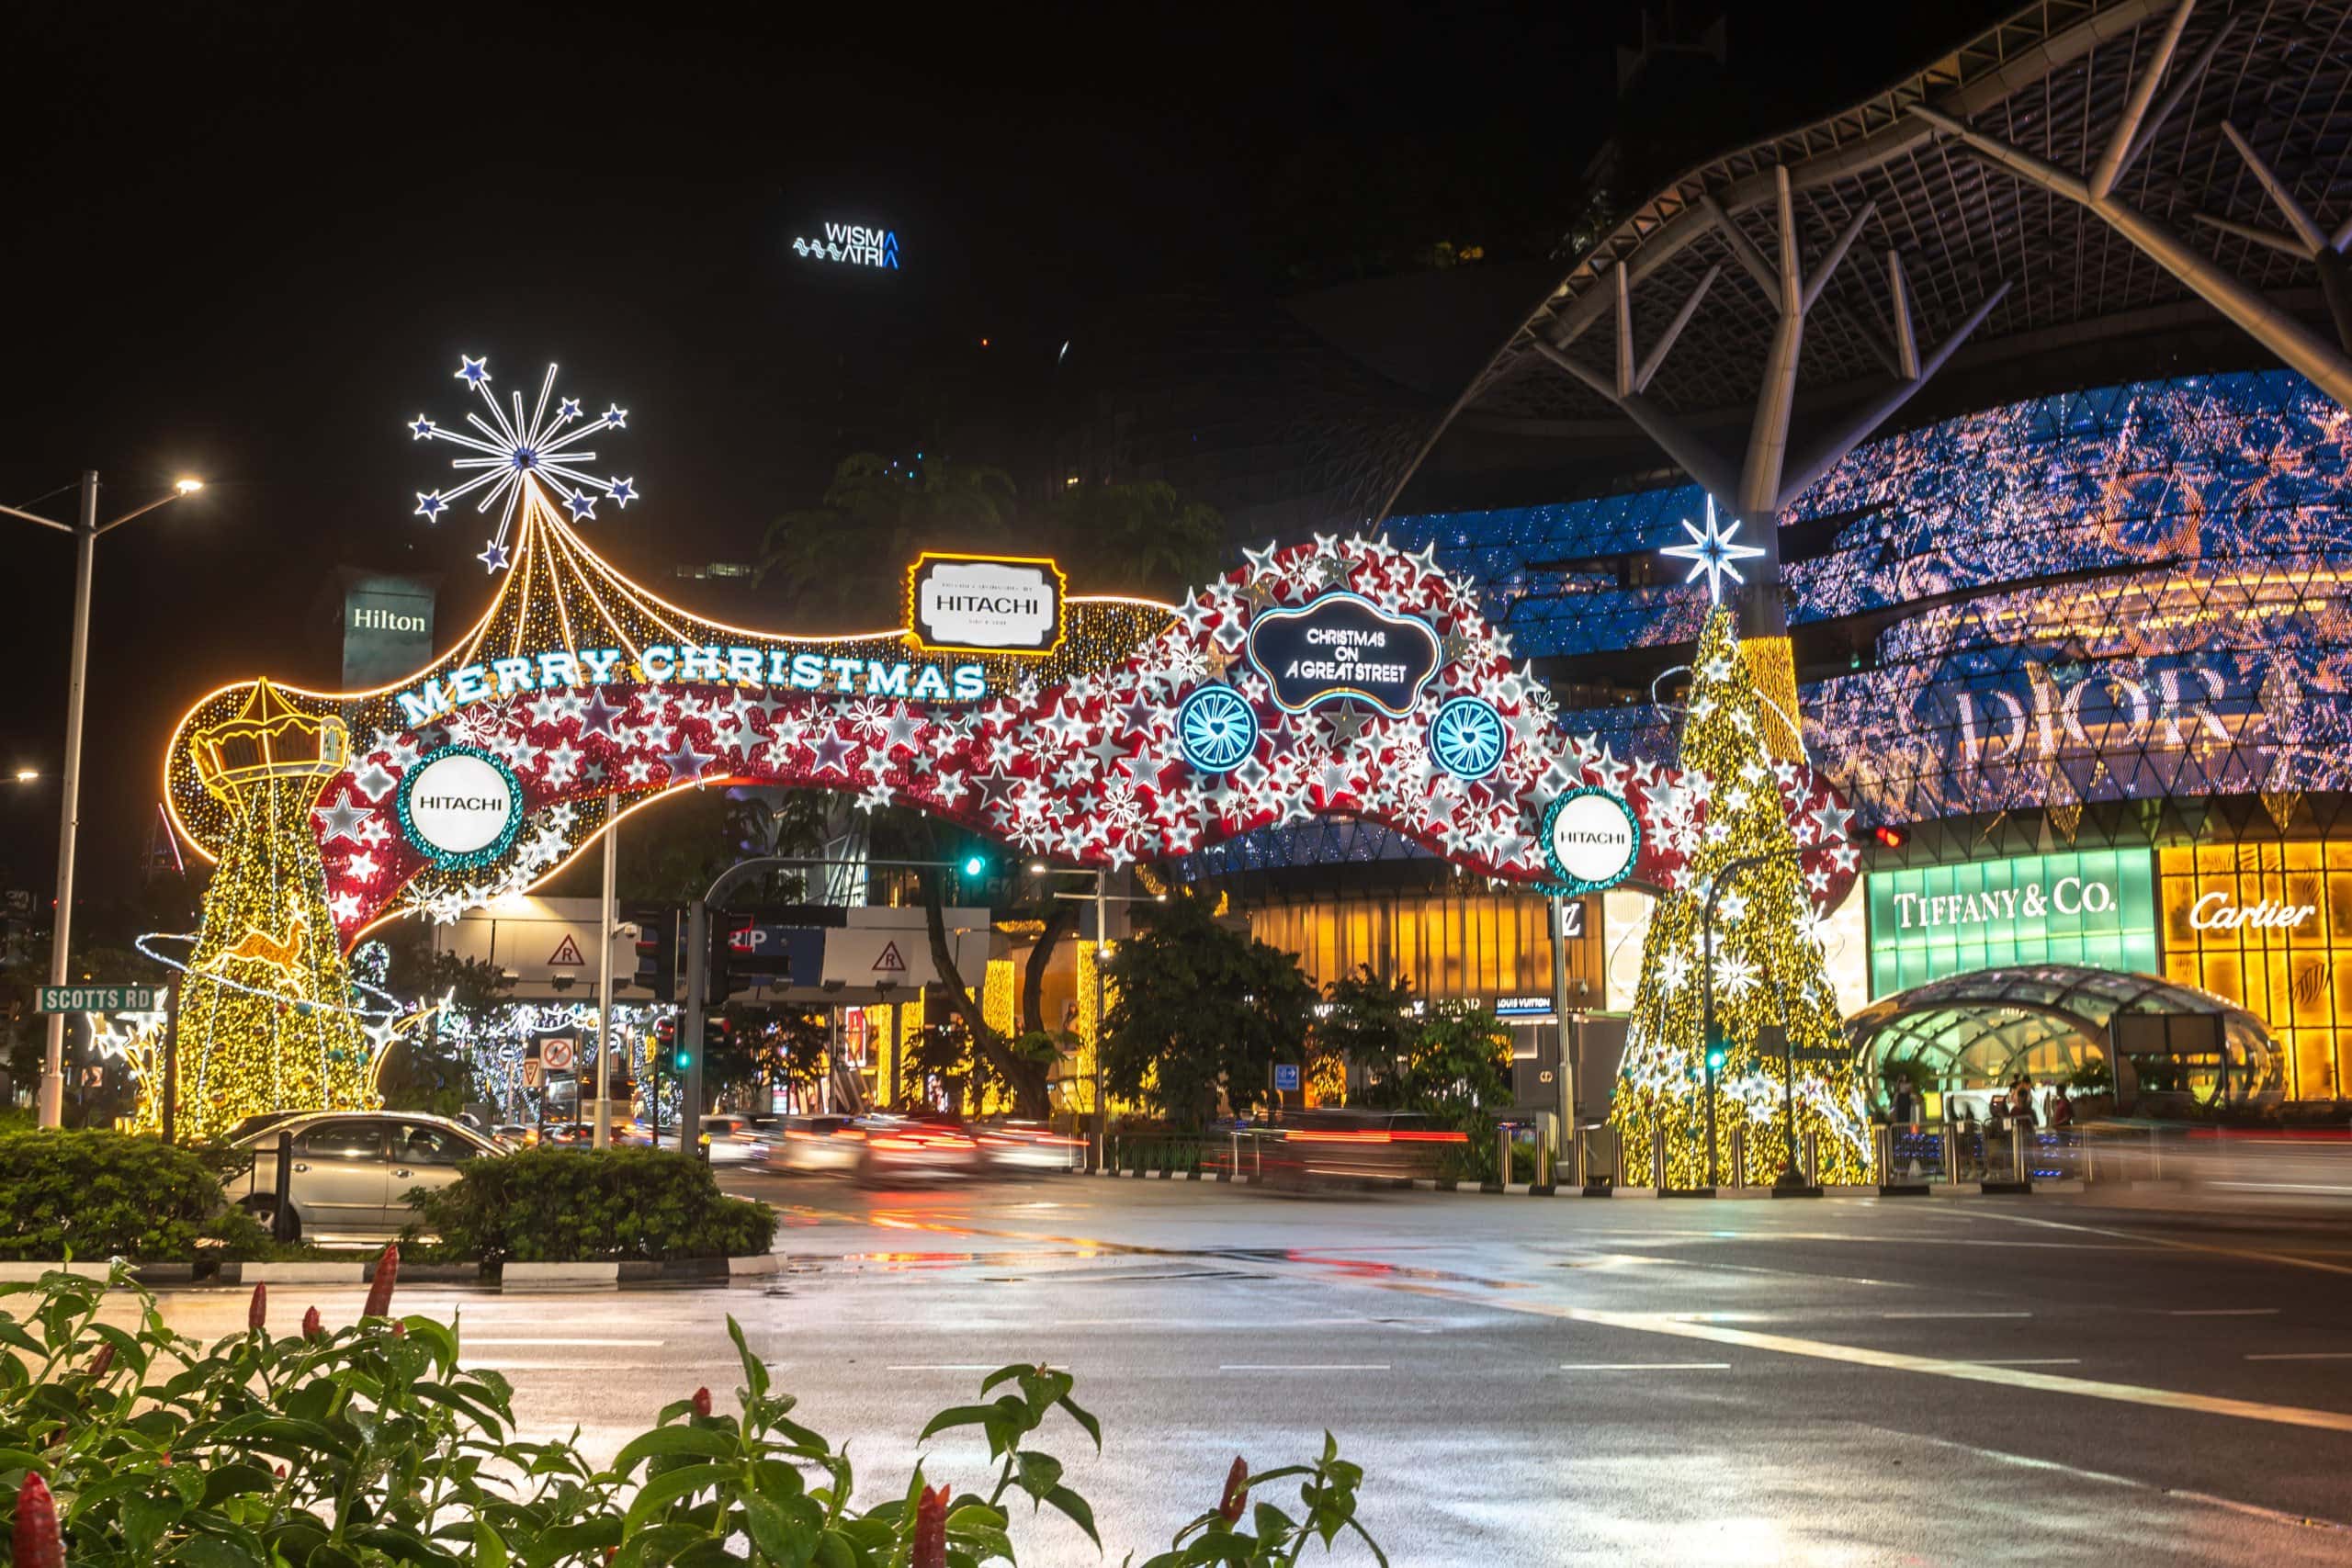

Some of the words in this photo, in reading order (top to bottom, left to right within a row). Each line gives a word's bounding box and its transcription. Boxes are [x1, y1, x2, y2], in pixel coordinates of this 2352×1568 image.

[825, 222, 899, 252] WISMA
[842, 244, 899, 269] ATRIA
[936, 594, 1038, 615] HITACHI
[354, 608, 425, 632] Hilton
[1306, 628, 1385, 647] CHRISTMAS
[1335, 646, 1359, 661] ON
[1285, 660, 1298, 679] A
[1301, 660, 1352, 681] GREAT
[1355, 662, 1407, 683] STREET
[396, 647, 620, 728] MERRY
[642, 645, 986, 699] CHRISTMAS
[420, 795, 502, 811] HITACHI
[1560, 831, 1624, 845] HITACHI
[1894, 888, 2019, 928] TIFFANY
[2023, 884, 2047, 917] &
[2189, 892, 2315, 930] Cartier
[561, 947, 573, 962] R
[886, 953, 895, 966] R
[47, 989, 100, 1010] SCOTTS
[125, 989, 150, 1009] RD
[1497, 998, 1517, 1009] LOUIS
[1519, 997, 1550, 1008] VUITTON
